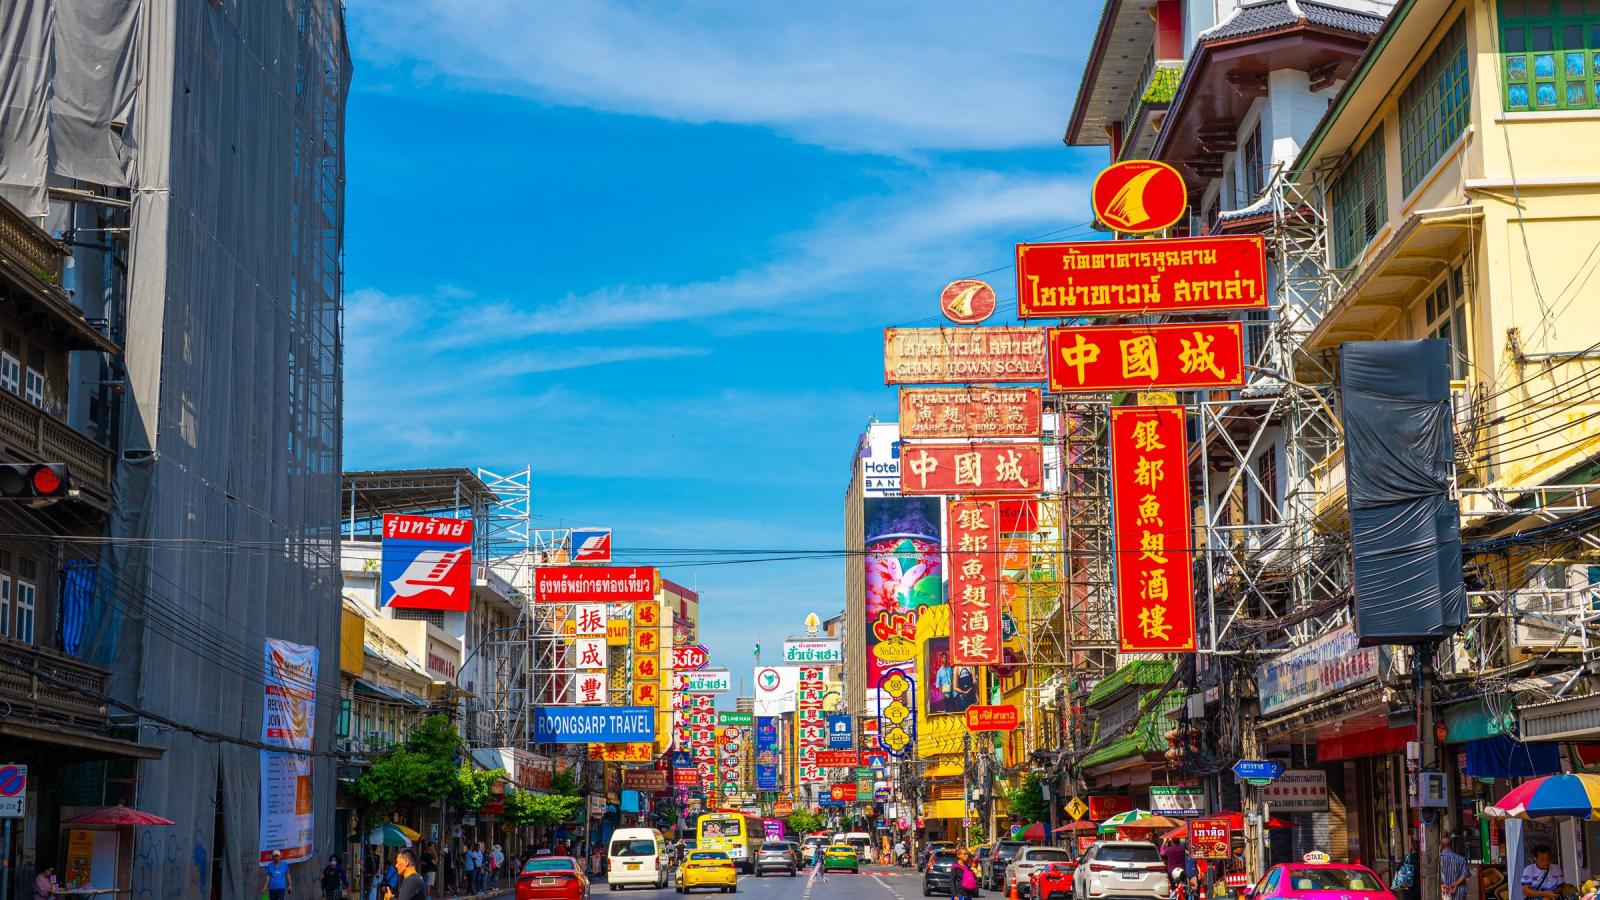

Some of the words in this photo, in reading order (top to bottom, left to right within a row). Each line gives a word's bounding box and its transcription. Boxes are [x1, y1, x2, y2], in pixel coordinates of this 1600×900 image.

[1062, 247, 1217, 273] ภัตตาคารหูฉลาม
[1027, 274, 1161, 307] ไชน่าทาวน์
[1173, 270, 1255, 302] สกาล่า
[896, 362, 941, 375] CHINA
[947, 361, 991, 374] TOWN
[996, 360, 1044, 374] SCALA
[1061, 331, 1225, 385] 中國城
[865, 461, 899, 473] Hotel
[909, 449, 1029, 489] 中國城
[865, 479, 901, 488] BAN
[388, 516, 468, 537] รุ่งทรัพย์
[1131, 419, 1172, 641] 銀都魚翅酒樓
[540, 568, 650, 600] รุ่งทรัพย์การท่องเที่ยว
[956, 509, 992, 660] 銀都魚翅酒樓
[577, 608, 605, 703] 振成豐
[538, 715, 606, 735] ROONGSARP
[610, 714, 651, 735] TRAVEL
[1271, 764, 1277, 774] 2
